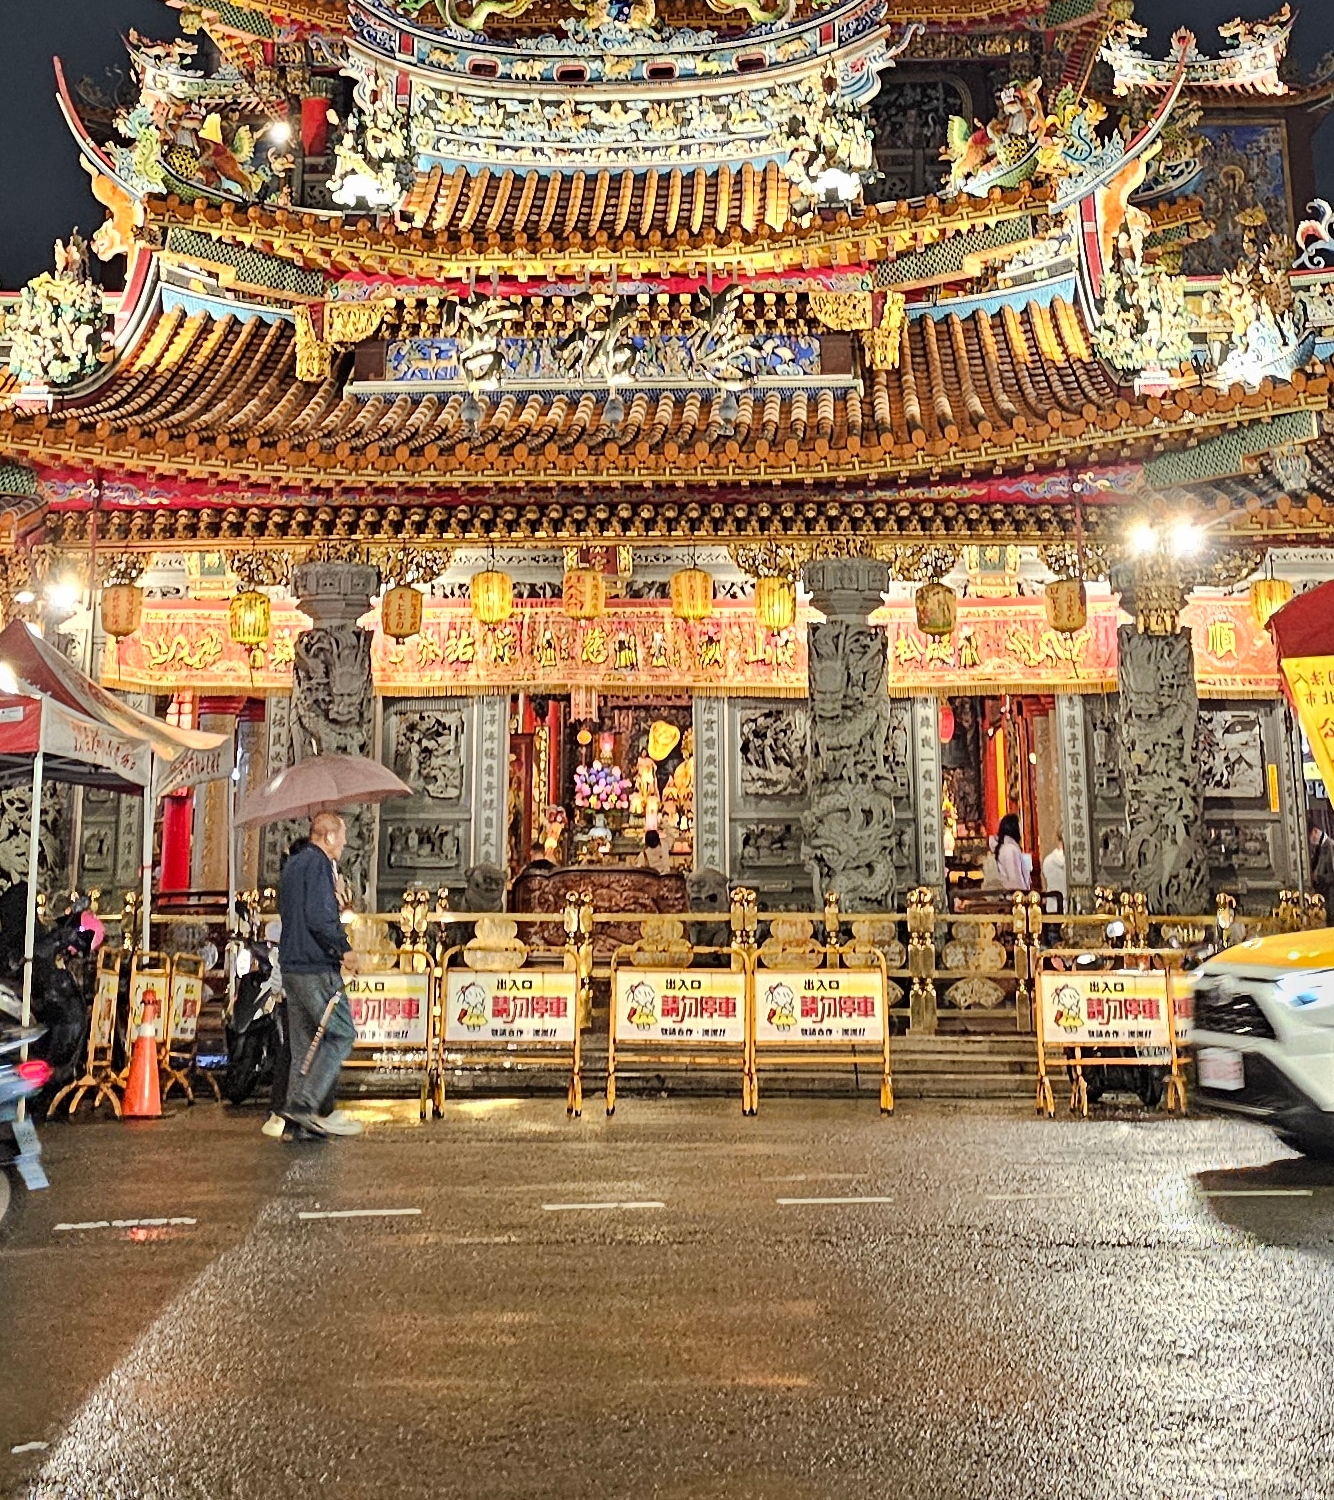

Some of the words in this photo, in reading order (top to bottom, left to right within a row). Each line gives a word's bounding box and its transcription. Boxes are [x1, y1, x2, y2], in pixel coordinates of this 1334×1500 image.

[349, 980, 385, 993] 出入口
[497, 978, 532, 991] 出入口
[665, 978, 702, 991] 出入口
[804, 978, 840, 991] 出入口
[1089, 981, 1125, 994] 出入口
[490, 995, 568, 1024] 請勿停車
[660, 994, 737, 1023] 請勿停車
[799, 994, 876, 1023] 請勿停車
[1086, 997, 1161, 1026] 請勿停車
